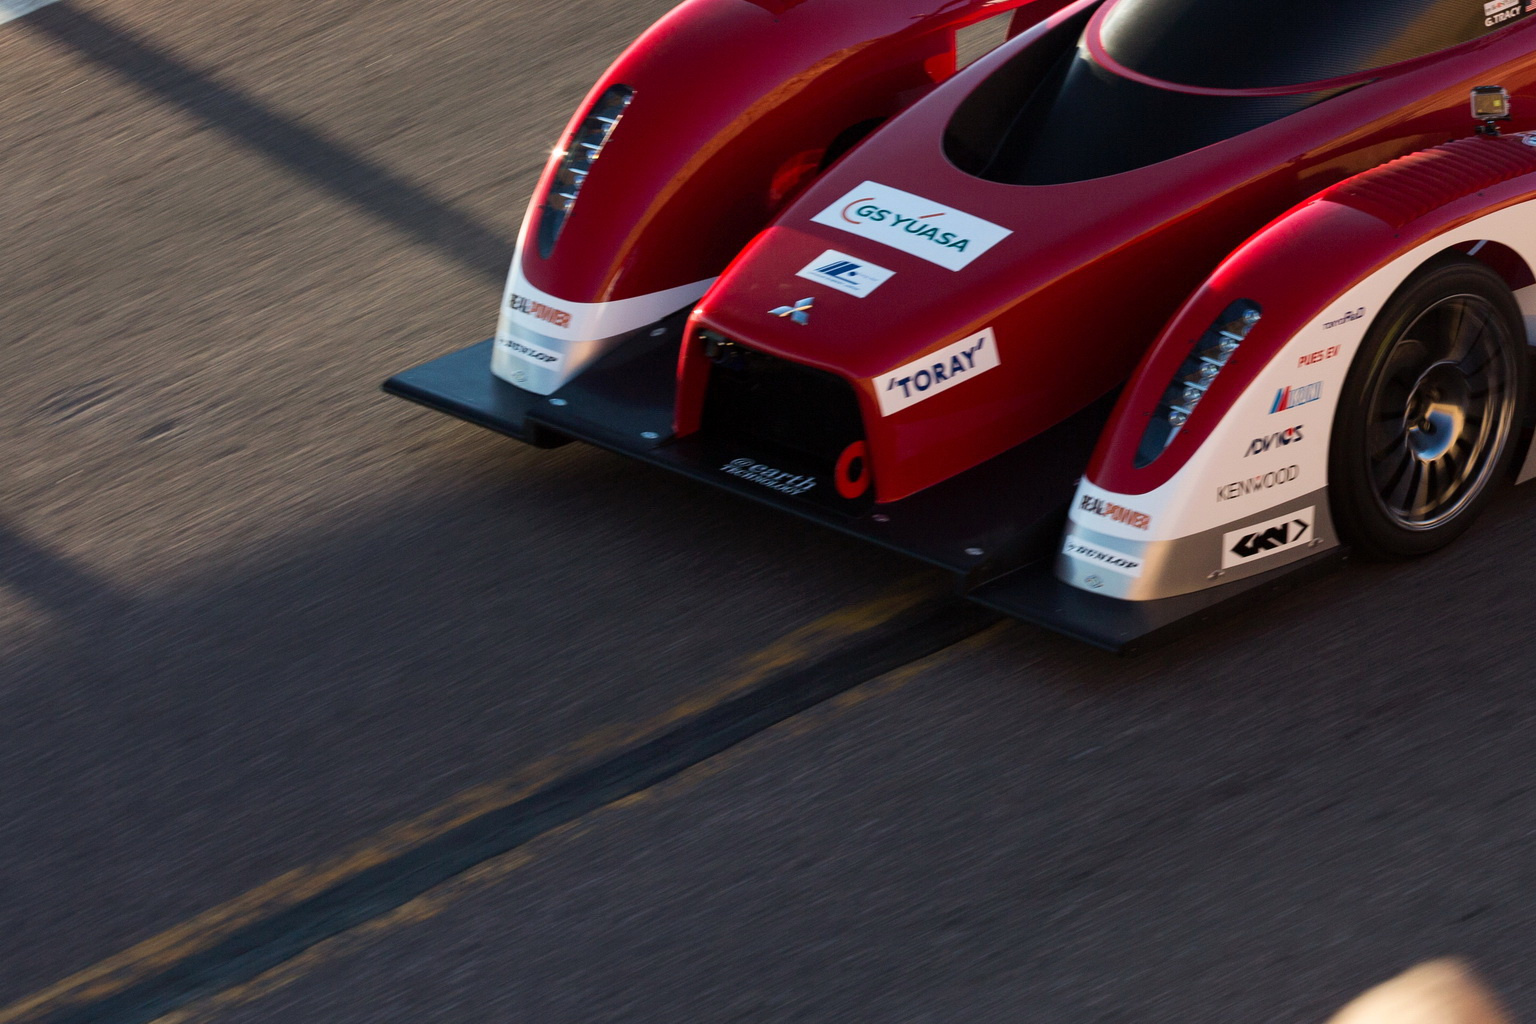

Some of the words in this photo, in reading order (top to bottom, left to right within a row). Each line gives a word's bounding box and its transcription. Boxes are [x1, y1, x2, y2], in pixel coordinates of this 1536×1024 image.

[1484, 5, 1522, 27] G.TRACY
[856, 205, 891, 222] GS
[891, 214, 971, 253] YUASA
[1216, 464, 1300, 503] KENWOOD
